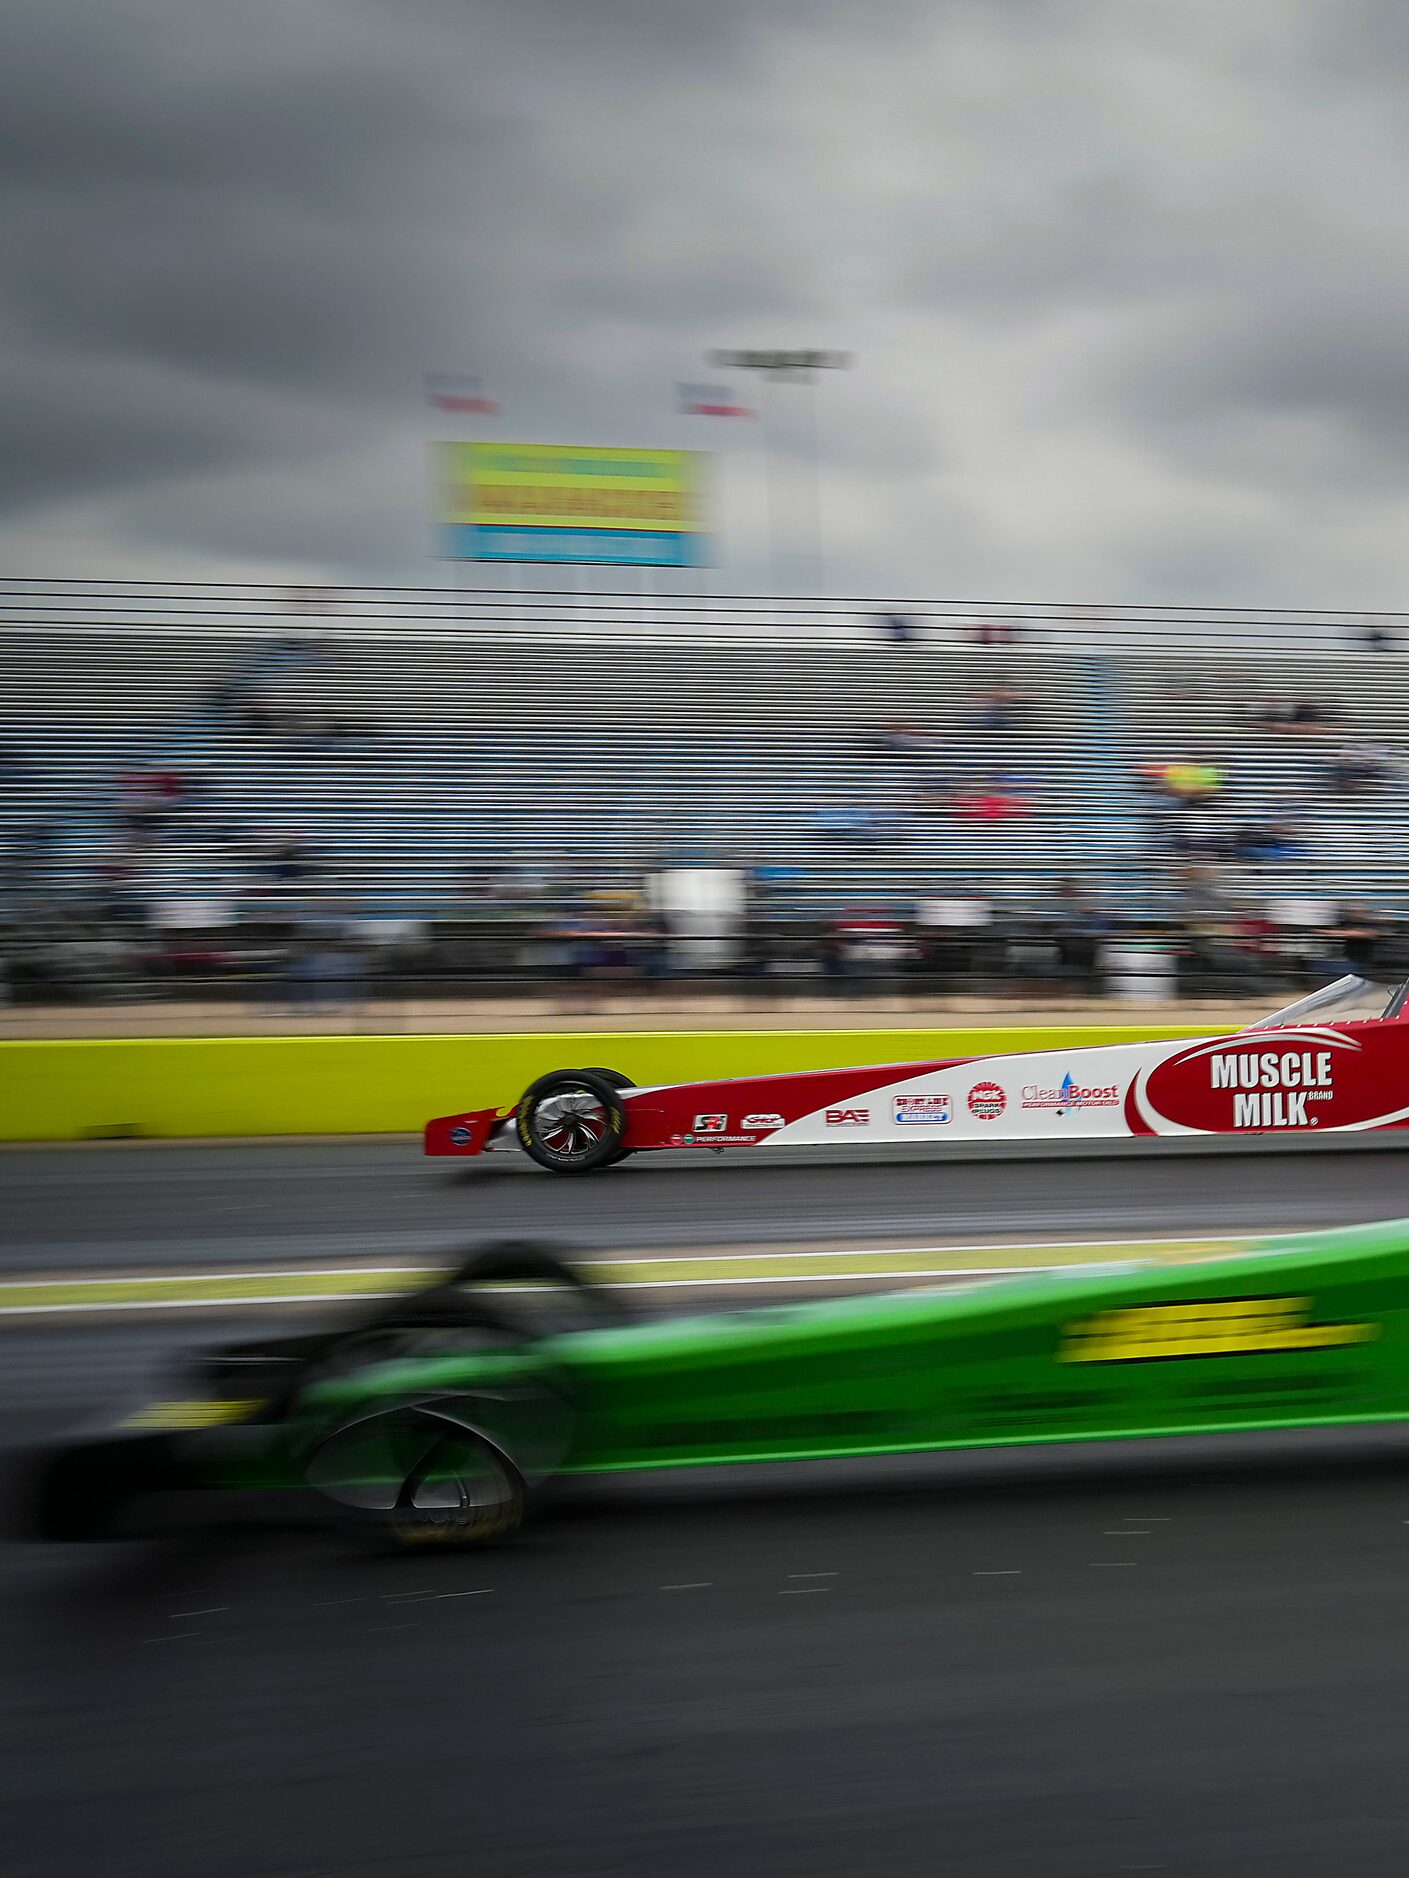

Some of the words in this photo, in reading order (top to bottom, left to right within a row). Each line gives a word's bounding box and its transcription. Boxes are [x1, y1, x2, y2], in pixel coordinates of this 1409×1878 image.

[1211, 1052, 1332, 1089] MUSCLE
[972, 1090, 1001, 1100] NGK
[1021, 1084, 1119, 1101] CleanBoost
[1308, 1091, 1333, 1100] BRAND
[826, 1110, 870, 1123] BAE
[1233, 1092, 1308, 1128] MILK
